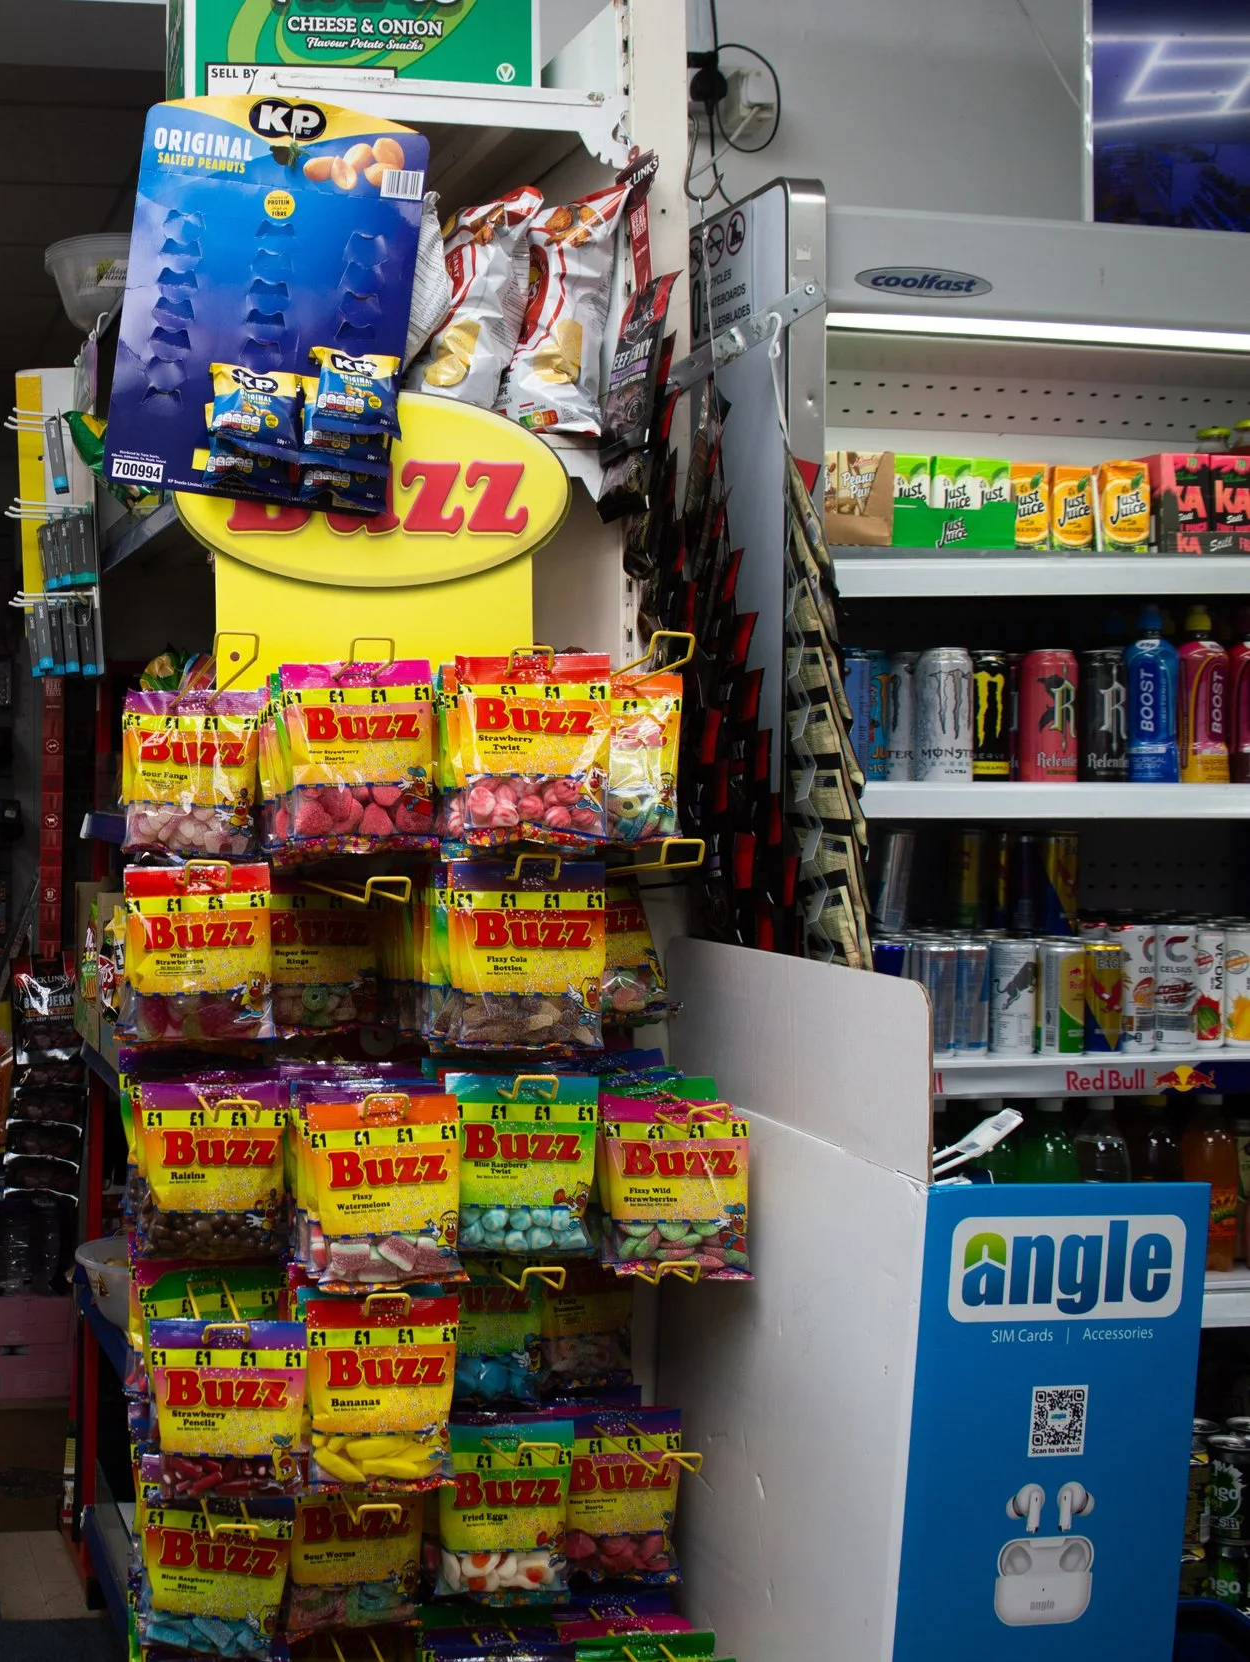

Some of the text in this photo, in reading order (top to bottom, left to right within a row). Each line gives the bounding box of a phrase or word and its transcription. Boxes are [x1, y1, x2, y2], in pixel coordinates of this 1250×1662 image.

[286, 16, 443, 37] CHEESE & ONION
[306, 36, 424, 51] Flavour Potato Snacks
[211, 68, 241, 80] SELL
[258, 104, 321, 134] KP
[153, 126, 253, 162] ORIGINAL
[157, 151, 246, 174] SALTED PEANUTS
[871, 274, 978, 293] coolfast
[240, 374, 276, 391] KP
[339, 373, 374, 386] ORIGINAL
[114, 461, 161, 480] 700994
[1209, 536, 1234, 552] Still
[1140, 668, 1155, 732] BOOST
[1211, 671, 1224, 733] BOOST
[126, 715, 141, 727] £1
[473, 697, 594, 735] Buzz
[301, 706, 421, 742] Buzz
[478, 734, 533, 744] Strawberry
[138, 730, 246, 766] Buzz
[492, 743, 520, 752] Twist
[141, 770, 189, 781] Sour Fangs
[208, 897, 224, 909] £1
[143, 915, 256, 951] Buzz
[472, 911, 593, 949] Buzz
[155, 958, 204, 966] Strawberries
[486, 956, 508, 964] Fizzy
[1215, 943, 1223, 990] MO-JA
[493, 964, 523, 972] Bottles
[1160, 965, 1193, 973] CELSIUS
[1066, 1069, 1145, 1091] Red Bull
[397, 1128, 413, 1142] £1
[461, 1123, 582, 1162] Buzz
[160, 1130, 277, 1167] Buzz
[491, 1162, 528, 1170] Raspberry
[620, 1140, 739, 1177] Buzz
[170, 1171, 206, 1180] Raisins
[326, 1150, 449, 1190] Buzz
[352, 1193, 373, 1201] Fizzy
[629, 1187, 651, 1195] Fizzy
[337, 1201, 391, 1210] Watermelons
[961, 1219, 1173, 1316] angle
[354, 1330, 370, 1345] £1
[991, 1328, 1054, 1343] SIM Cards
[1082, 1326, 1154, 1341] Accessories
[325, 1350, 447, 1389] Buzz
[165, 1368, 289, 1409] Buzz
[331, 1398, 381, 1407] Bananas
[171, 1410, 226, 1420] Strawberry
[182, 1418, 216, 1427] Pencils
[1070, 1445, 1081, 1453] us!
[569, 1457, 672, 1493] Buzz
[453, 1471, 563, 1508] Buzz
[301, 1505, 411, 1543] Buzz
[462, 1512, 509, 1522] Fried Eggs
[159, 1528, 278, 1577] Buzz
[303, 1551, 356, 1561] Sour Worms
[178, 1575, 215, 1585] Raspberry
[1030, 1599, 1055, 1612] angle
